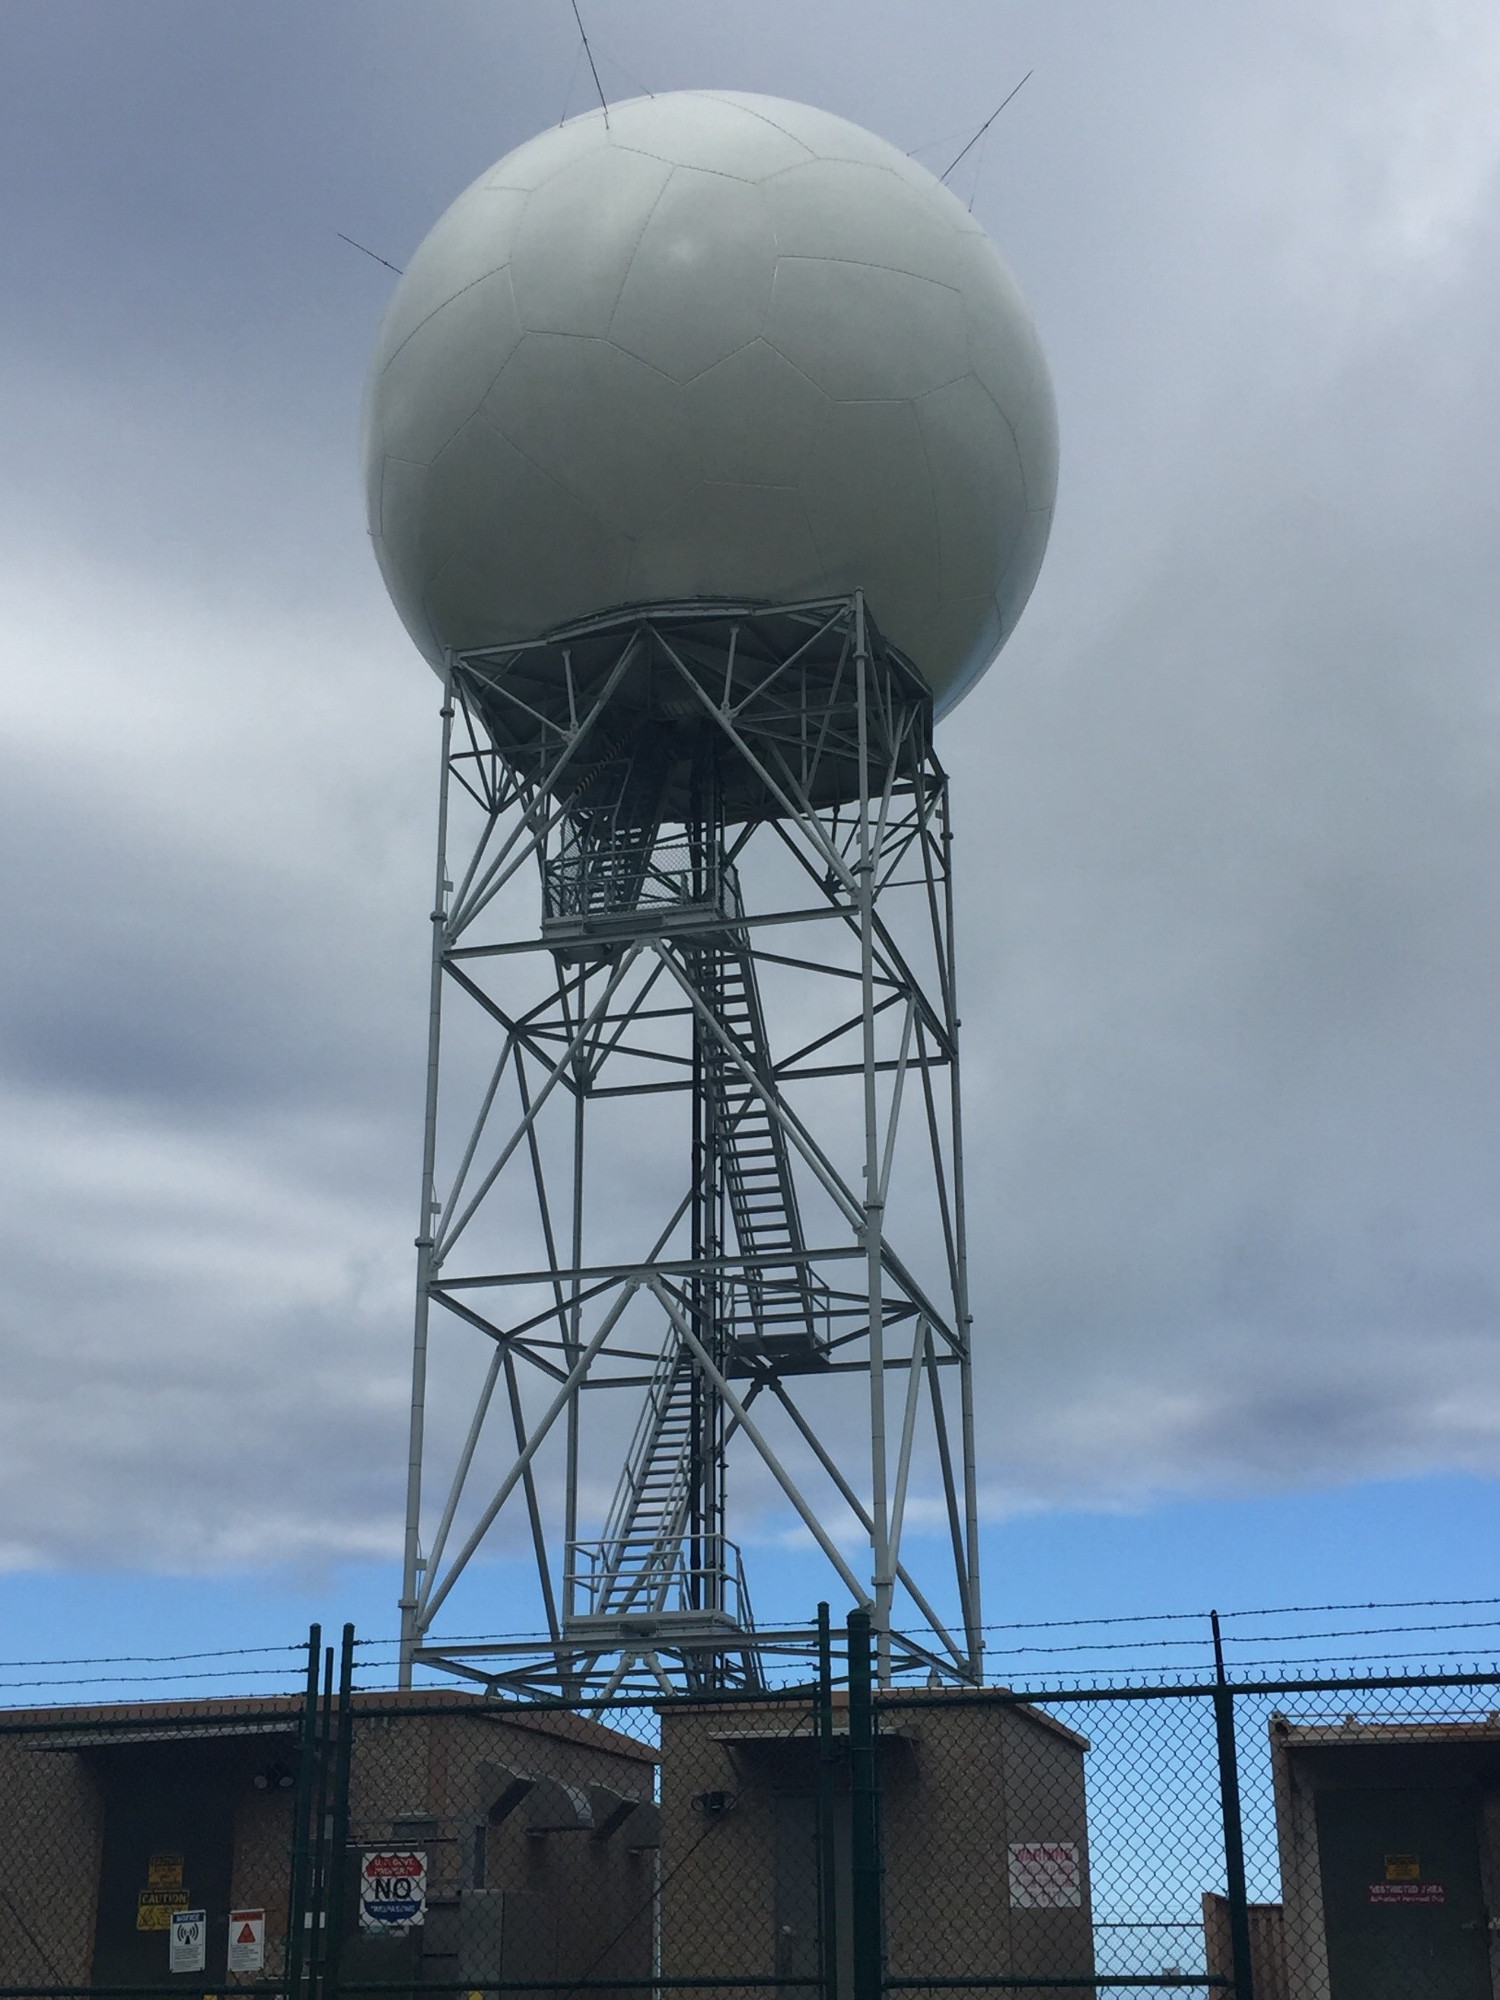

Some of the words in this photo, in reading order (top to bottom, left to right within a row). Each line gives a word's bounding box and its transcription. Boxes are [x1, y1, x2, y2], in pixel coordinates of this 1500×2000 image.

[1014, 1848, 1073, 1861] WARNING
[374, 1878, 411, 1899] NO
[142, 1893, 187, 1904] CAUTION
[176, 1913, 200, 1922] NOTICE
